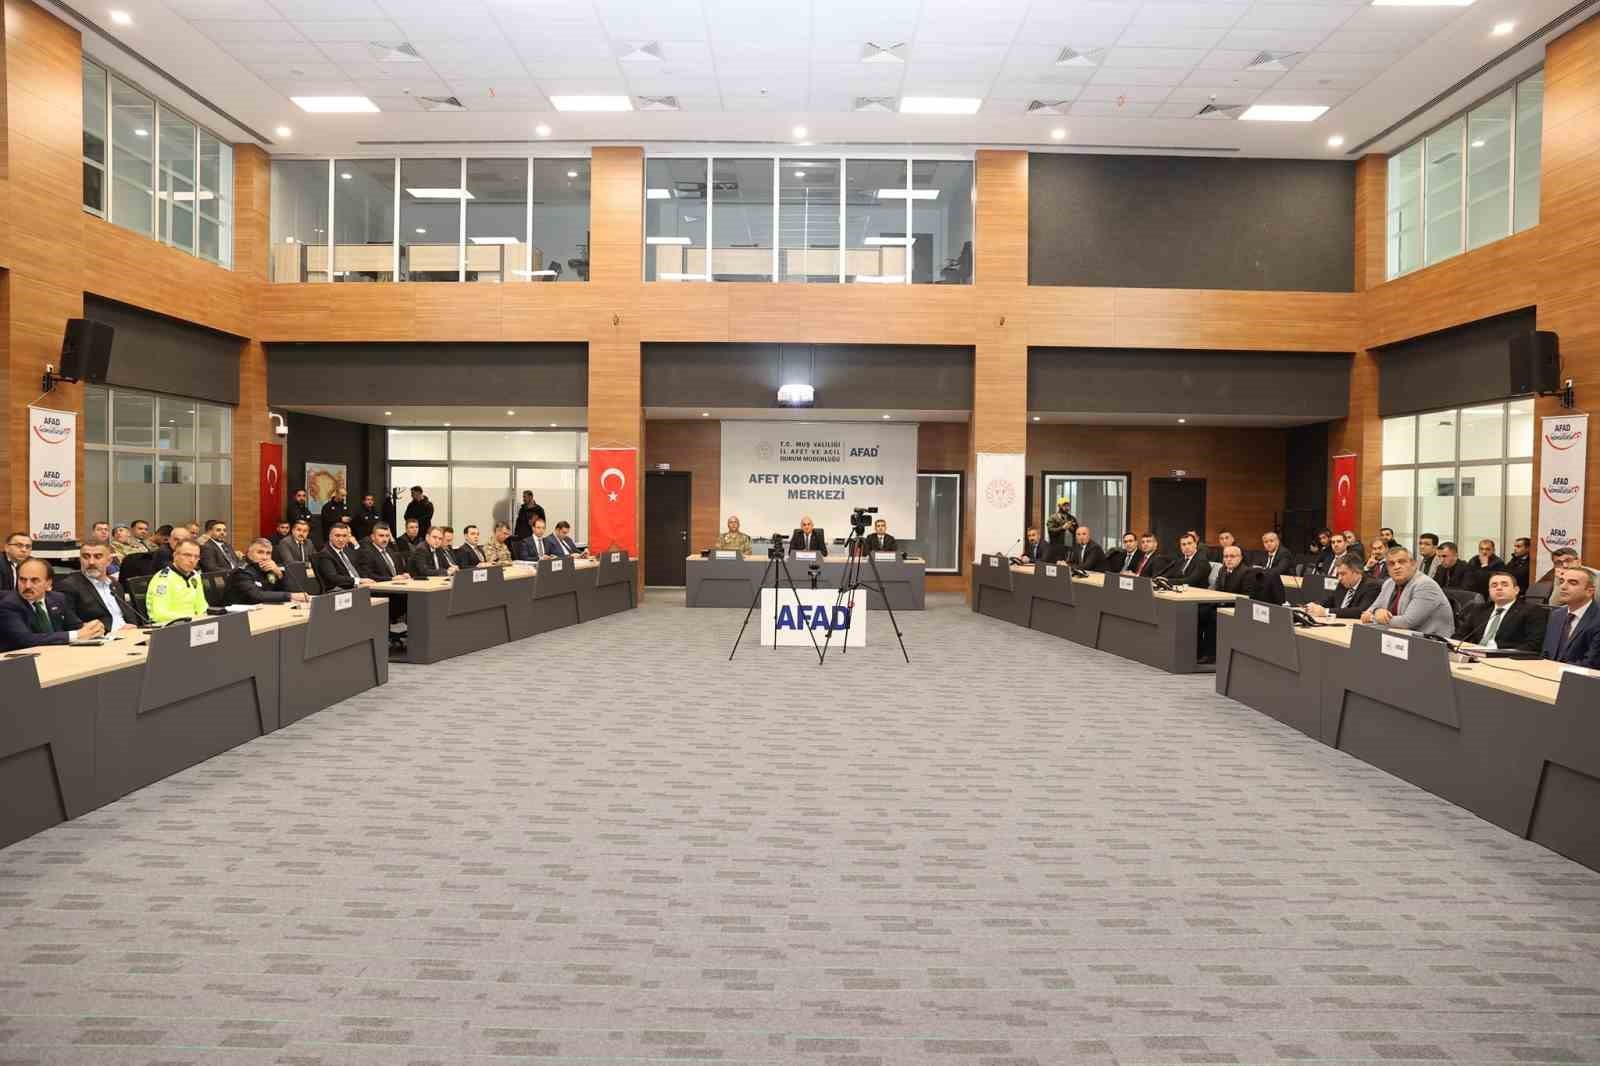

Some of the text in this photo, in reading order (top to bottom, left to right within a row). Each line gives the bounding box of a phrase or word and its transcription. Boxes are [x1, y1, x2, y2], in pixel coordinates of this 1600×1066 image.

[43, 416, 61, 425] AFAD
[850, 446, 879, 458] AFAD
[43, 471, 61, 480] AFAD
[748, 472, 885, 486] AFET KOORDİNASYON
[787, 488, 846, 501] MERKEZİ
[775, 604, 850, 631] AFAD
